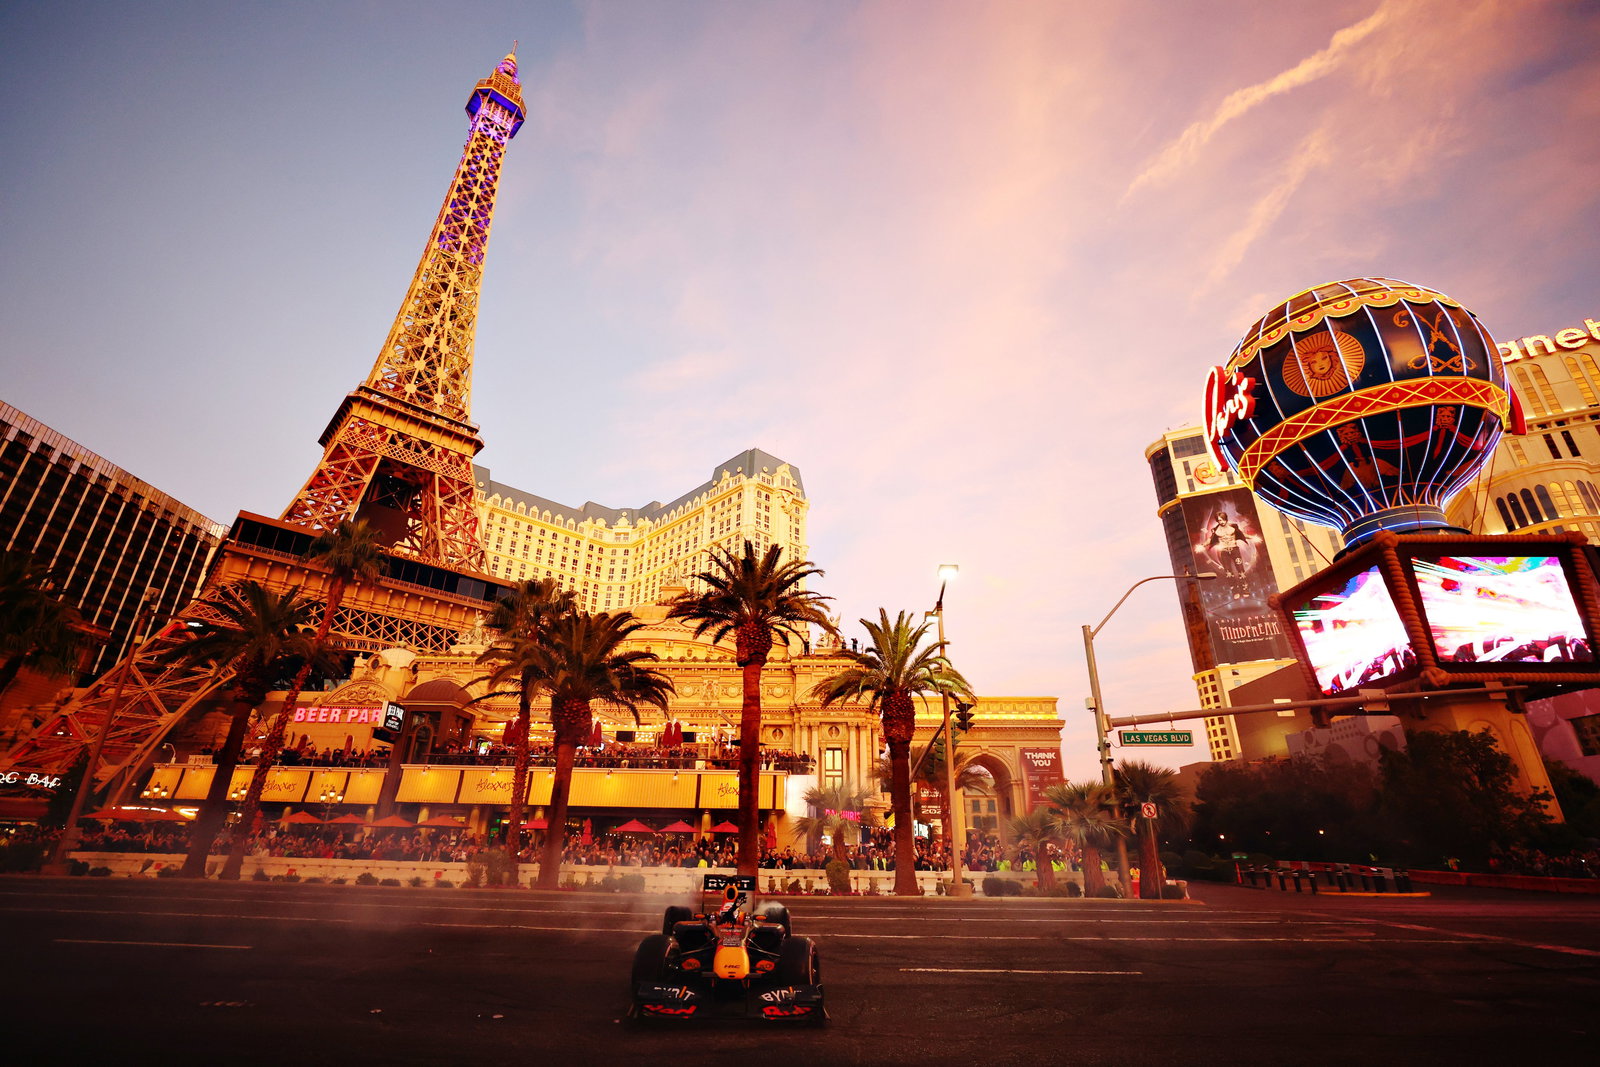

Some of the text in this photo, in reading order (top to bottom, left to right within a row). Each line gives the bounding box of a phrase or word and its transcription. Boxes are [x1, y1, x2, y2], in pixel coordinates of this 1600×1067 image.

[1496, 318, 1600, 363] anet
[1202, 365, 1256, 472] Paris
[1219, 621, 1281, 641] MINDFREAK
[294, 707, 382, 723] BEER PAR
[1125, 734, 1189, 743] LAS VEGAS BLVD
[1024, 752, 1056, 760] THANK
